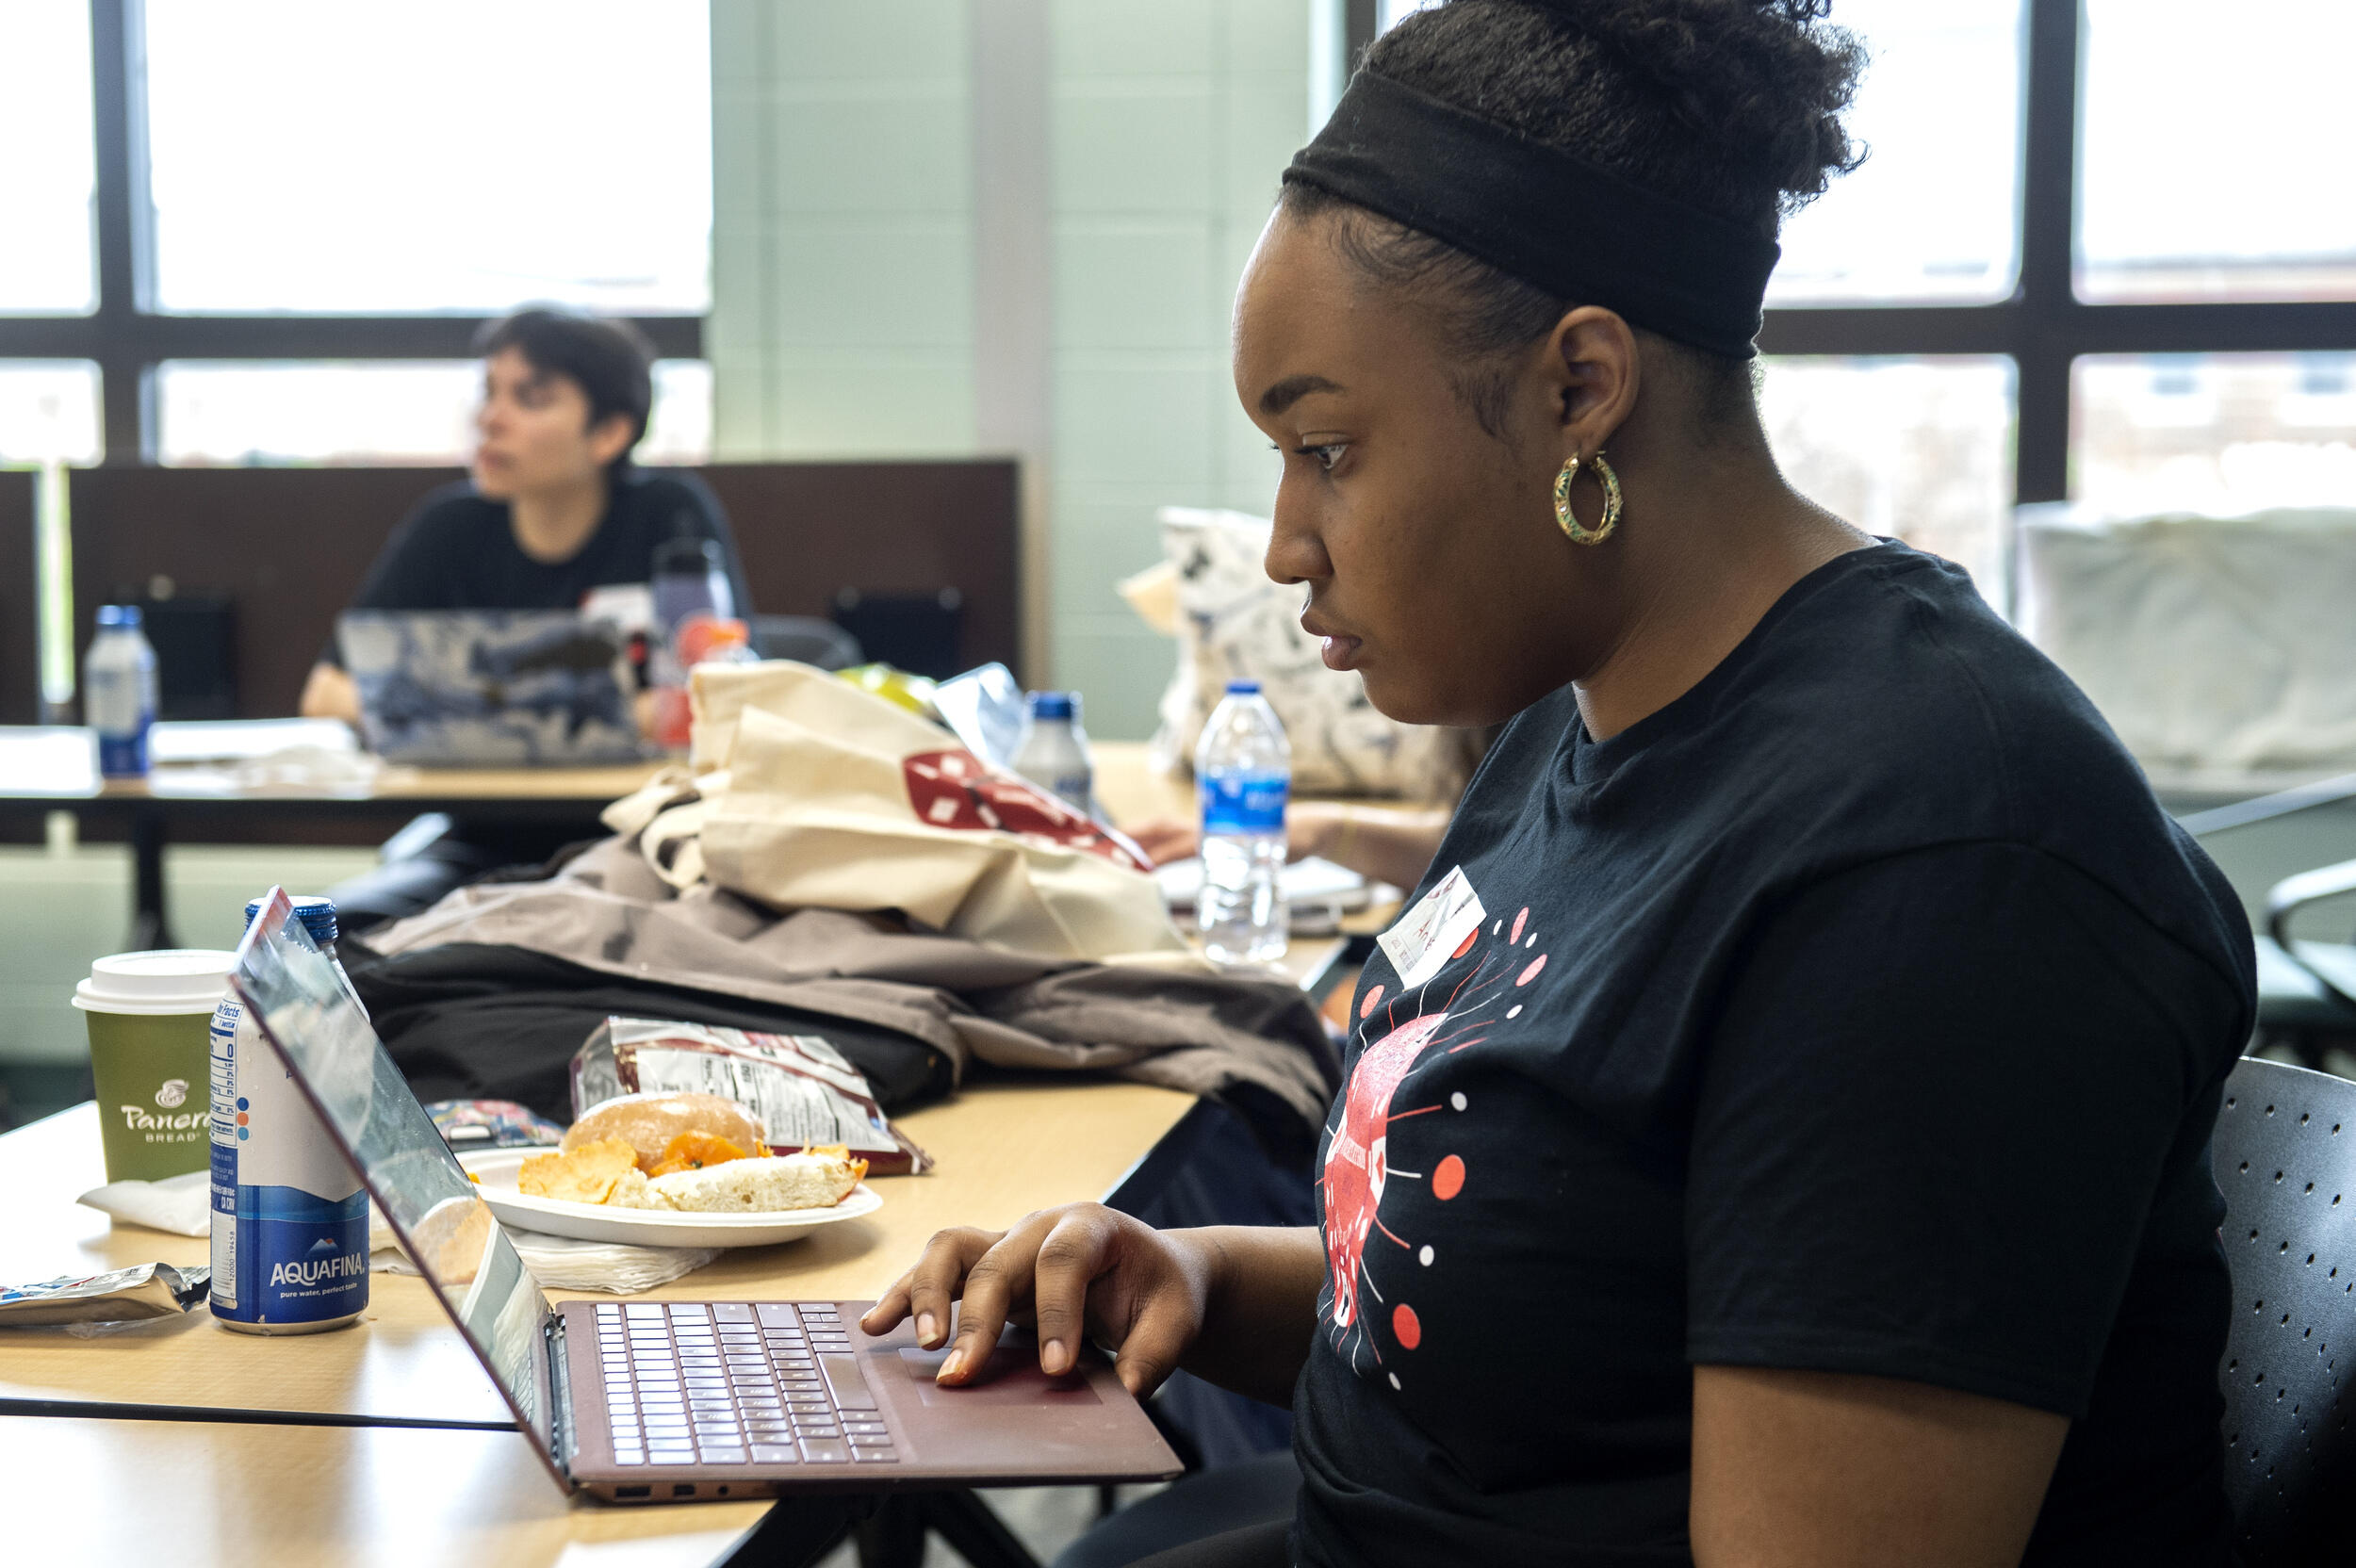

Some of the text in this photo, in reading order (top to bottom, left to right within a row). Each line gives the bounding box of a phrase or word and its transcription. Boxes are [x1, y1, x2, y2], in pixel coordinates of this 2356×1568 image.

[222, 1004, 239, 1018] Facts
[227, 1043, 234, 1058] 0
[145, 1132, 196, 1143] BREAD
[270, 1252, 363, 1288] AQUAFINA
[280, 1290, 298, 1298] pure
[321, 1283, 345, 1297] perfect
